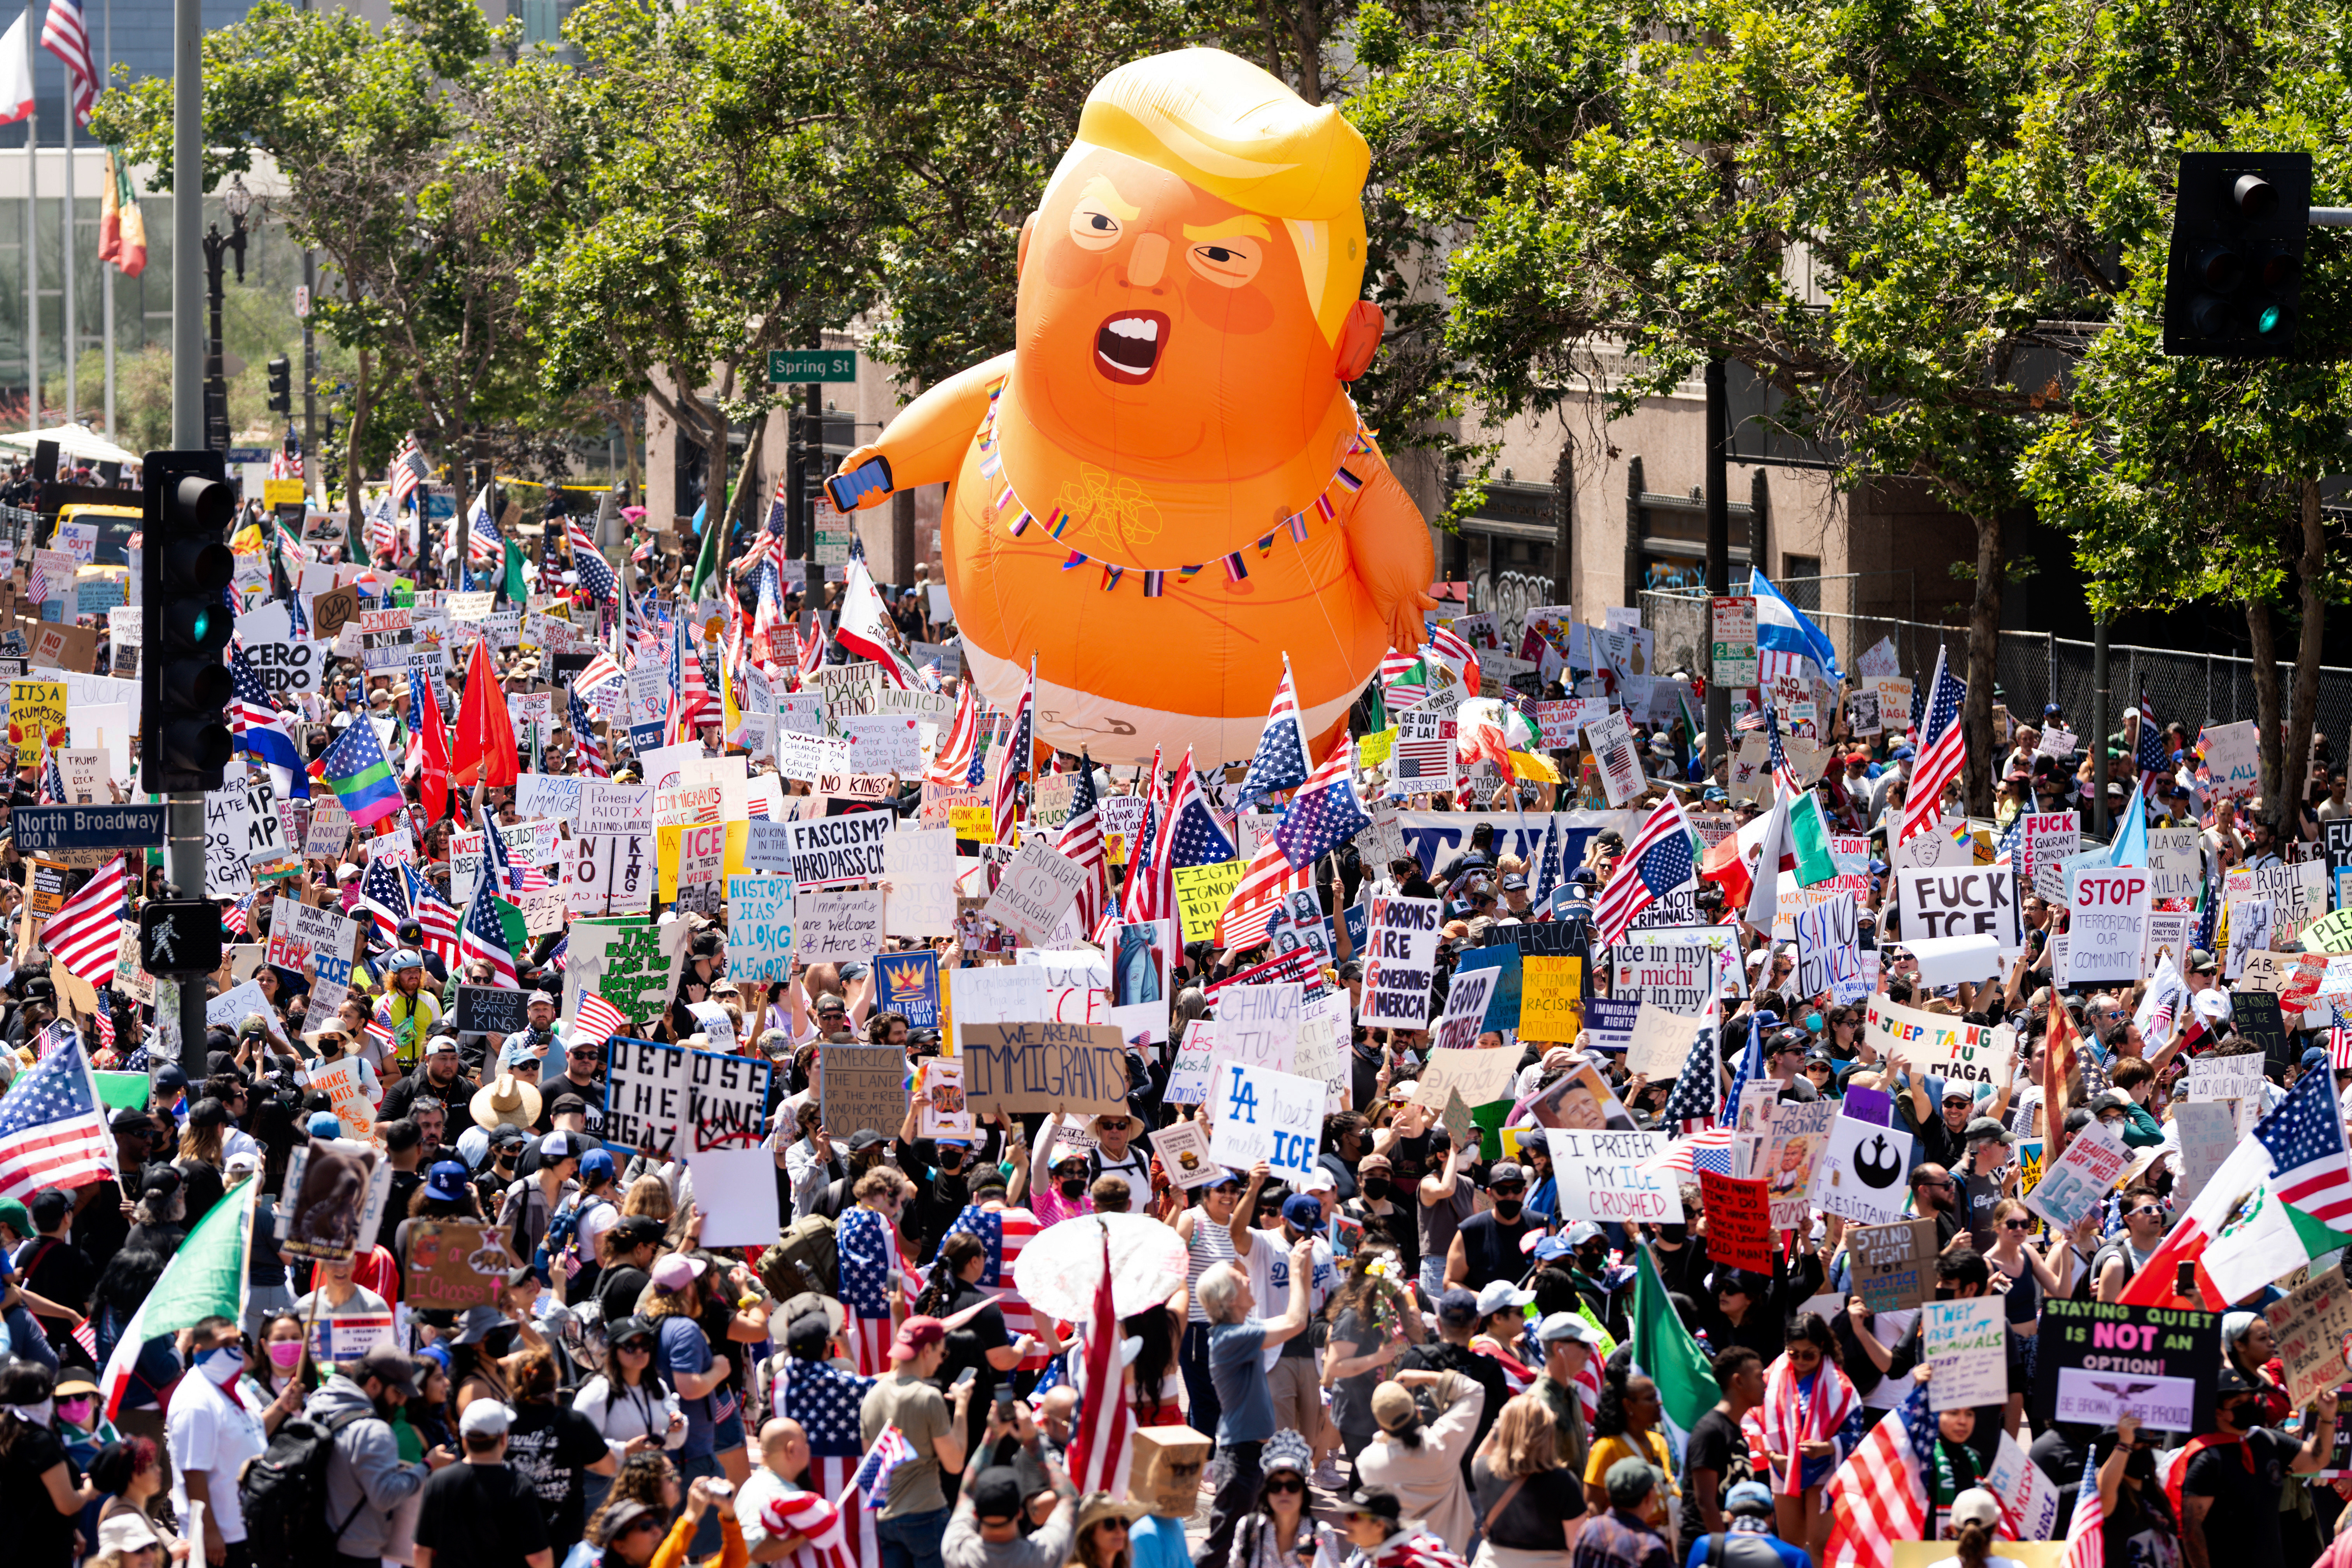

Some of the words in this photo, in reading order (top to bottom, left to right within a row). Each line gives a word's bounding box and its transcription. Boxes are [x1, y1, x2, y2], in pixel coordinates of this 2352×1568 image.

[776, 359, 826, 376] Spring
[832, 360, 849, 373] St
[361, 609, 411, 630] DEMOCRACY
[44, 632, 61, 649] NO
[374, 632, 401, 647] NOT
[38, 646, 57, 658] KINGS
[244, 644, 311, 667] CERO
[1716, 644, 1724, 655] 2
[821, 663, 875, 686] PROTECT
[14, 684, 45, 700] IT'S
[51, 688, 59, 700] A
[825, 680, 873, 702] DACA
[1537, 699, 1586, 712] IMPEACH
[10, 708, 66, 729] TRUMPSTER
[1402, 713, 1415, 723] ICE
[1418, 714, 1438, 724] OUT
[1537, 710, 1578, 723] TRUMP
[1591, 711, 1623, 737] MILLIONS
[849, 722, 886, 734] Tenemos
[891, 726, 906, 735] que
[1402, 727, 1413, 737] OF
[1417, 727, 1435, 738] LA!
[1540, 728, 1555, 737] NO
[1603, 732, 1613, 740] OF
[1540, 736, 1567, 748] KING
[1596, 733, 1633, 756] IMMIGRANTS
[67, 756, 98, 766] TRUMP
[73, 776, 95, 784] DICK
[820, 775, 840, 793] NO
[849, 777, 887, 794] KINGS
[1616, 770, 1632, 784] ZERO
[591, 787, 632, 805] Protest
[1616, 781, 1637, 798] KINGS
[592, 806, 630, 817] RIOT
[18, 813, 70, 832] North
[75, 811, 159, 834] Broadway
[584, 820, 622, 831] LATINOS
[19, 833, 41, 847] 100
[47, 832, 57, 847] N
[312, 826, 348, 838] KINDNESS
[794, 815, 889, 856] FASCISM?
[308, 841, 340, 854] COURAGE
[687, 825, 722, 859] ICE
[686, 862, 695, 870] IN
[698, 857, 718, 867] THEIR
[1022, 843, 1082, 891] ENOUGH
[687, 870, 712, 883] VEINS
[1028, 875, 1047, 895] IS
[730, 878, 794, 909] HISTORY
[1662, 891, 1693, 908] NOT
[1915, 873, 2010, 909] FUCK
[2079, 879, 2145, 906] STOP
[521, 894, 566, 910] ABOLISH
[813, 897, 876, 920] Immigrants
[300, 907, 324, 924] DRINK
[327, 917, 343, 931] MY
[524, 912, 555, 929] ICE
[738, 903, 778, 920] HAS
[1371, 899, 1437, 930] MORONS
[1630, 907, 1695, 928] CRIMINALS
[297, 923, 335, 940] HORCHATA
[803, 920, 825, 931] are
[828, 914, 876, 931] welcome
[1799, 908, 1829, 954] SAY
[1830, 892, 1855, 946] NO
[2077, 914, 2142, 932] TERRORIZING
[286, 932, 306, 945] HOT
[314, 940, 338, 956] CAUSE
[729, 925, 743, 946] A
[747, 926, 791, 951] LONG
[821, 938, 856, 953] Here
[1369, 931, 1411, 959] ARE
[2096, 933, 2117, 946] OUR
[268, 940, 307, 971] FUCK
[315, 954, 352, 986] ICE
[1536, 957, 1566, 971] STOP
[1616, 946, 1647, 962] ice
[1651, 946, 1670, 961] in
[1675, 945, 1706, 968] my
[2075, 951, 2135, 968] COMMUNITY
[726, 956, 793, 983] MEMORY
[1641, 963, 1692, 985] michi
[1802, 959, 1822, 993] TO
[1824, 940, 1861, 986] NAZIS
[1367, 962, 1430, 990] GOVERNING
[1524, 974, 1580, 988] PRETENDING
[471, 992, 518, 1004] QUEENS
[1450, 977, 1487, 1011] GOOD
[1540, 988, 1559, 998] YOUR
[1616, 985, 1645, 1003] not
[1649, 985, 1670, 1003] in
[471, 1003, 516, 1013] AGAINST
[1364, 990, 1425, 1020] AMERICA
[1527, 998, 1575, 1011] RACISM
[475, 1016, 518, 1031] KINGS
[1522, 1022, 1577, 1038] PATRIOTISM
[1604, 1016, 1634, 1027] RIGHTS
[998, 1024, 1033, 1044] WE
[1042, 1024, 1065, 1041] ARE
[1067, 1023, 1093, 1043] ALL
[1438, 1015, 1482, 1049] TROUBLE
[825, 1048, 902, 1068] AMERICA
[825, 1073, 853, 1087] THE
[859, 1074, 899, 1087] LAND
[964, 1045, 1125, 1102] IMMIGRANTS
[825, 1090, 835, 1098] OF
[839, 1090, 866, 1100] THE
[872, 1092, 905, 1101] FREE
[1230, 1068, 1258, 1123] LA
[827, 1105, 851, 1114] AND
[853, 1104, 884, 1115] HOME
[888, 1105, 903, 1113] TO
[827, 1116, 852, 1135] NO
[1270, 1131, 1315, 1173] ICE
[1566, 1134, 1583, 1157] I
[1594, 1133, 1656, 1158] PREFER
[1586, 1166, 1615, 1187] MY
[1590, 1190, 1666, 1217] CRUSHED
[2047, 1300, 2130, 1318] STAYING
[2146, 1308, 2215, 1328] QUIET
[2065, 1326, 2086, 1342] IS
[2093, 1323, 2158, 1351] NOT
[2164, 1335, 2193, 1351] AN
[2082, 1354, 2166, 1376] OPTION!
